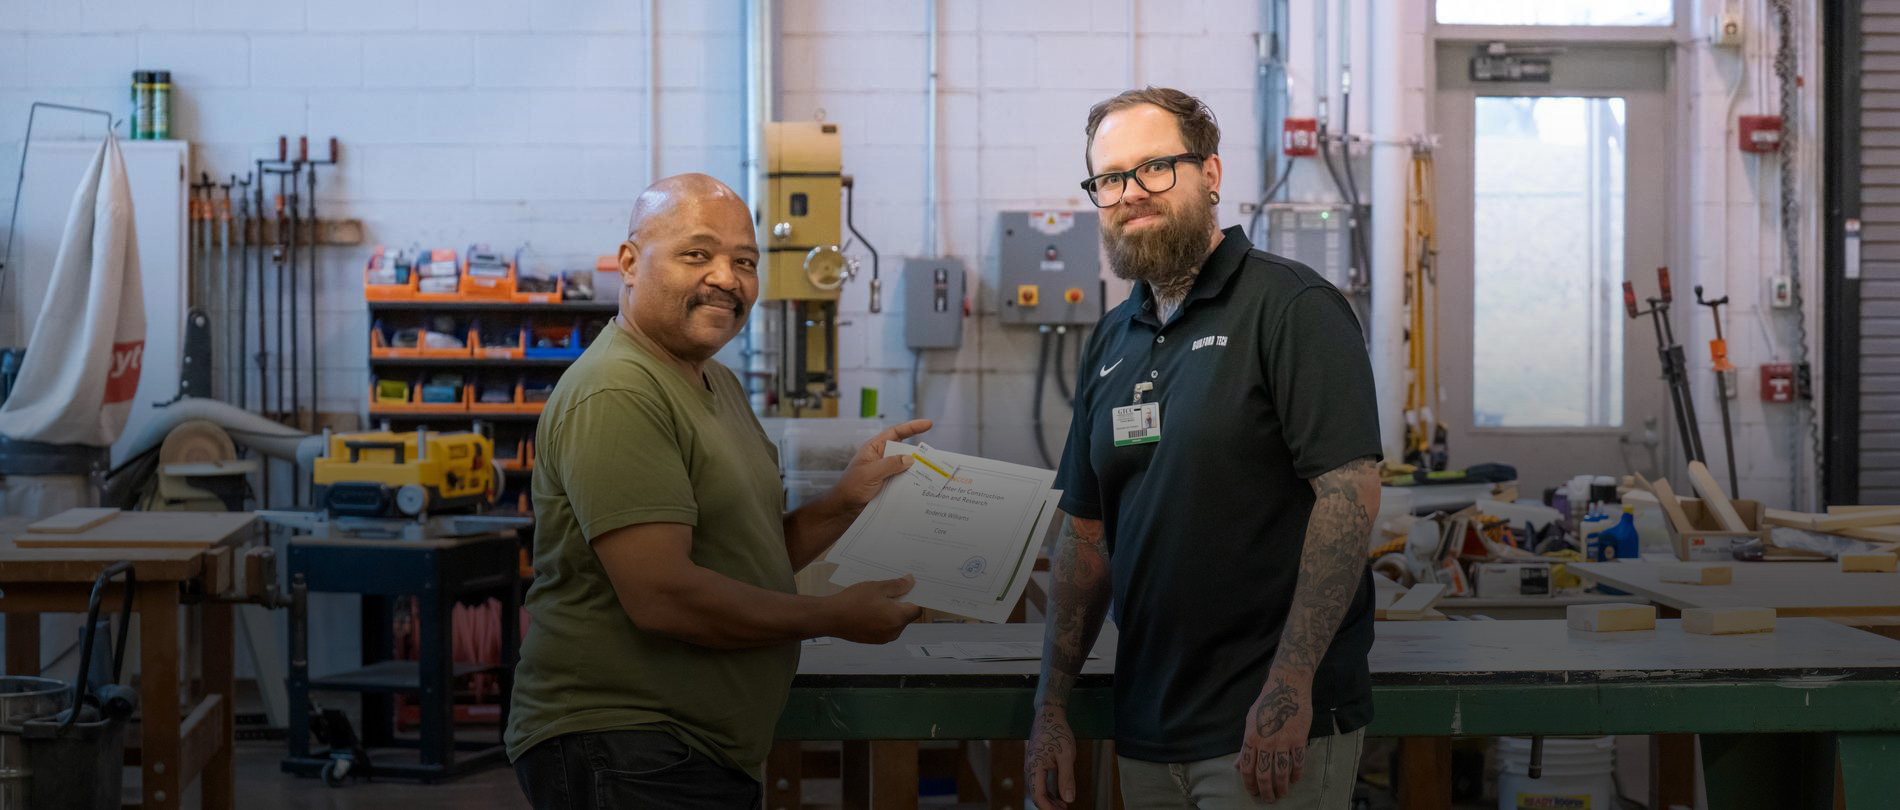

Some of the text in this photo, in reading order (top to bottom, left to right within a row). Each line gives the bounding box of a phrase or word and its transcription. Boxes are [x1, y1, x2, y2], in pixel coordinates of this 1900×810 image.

[1216, 335, 1228, 347] TECH
[1117, 407, 1133, 415] GTCC
[950, 494, 961, 502] and
[962, 497, 988, 506] Research
[967, 488, 1004, 501] Construction
[948, 511, 970, 522] Williams
